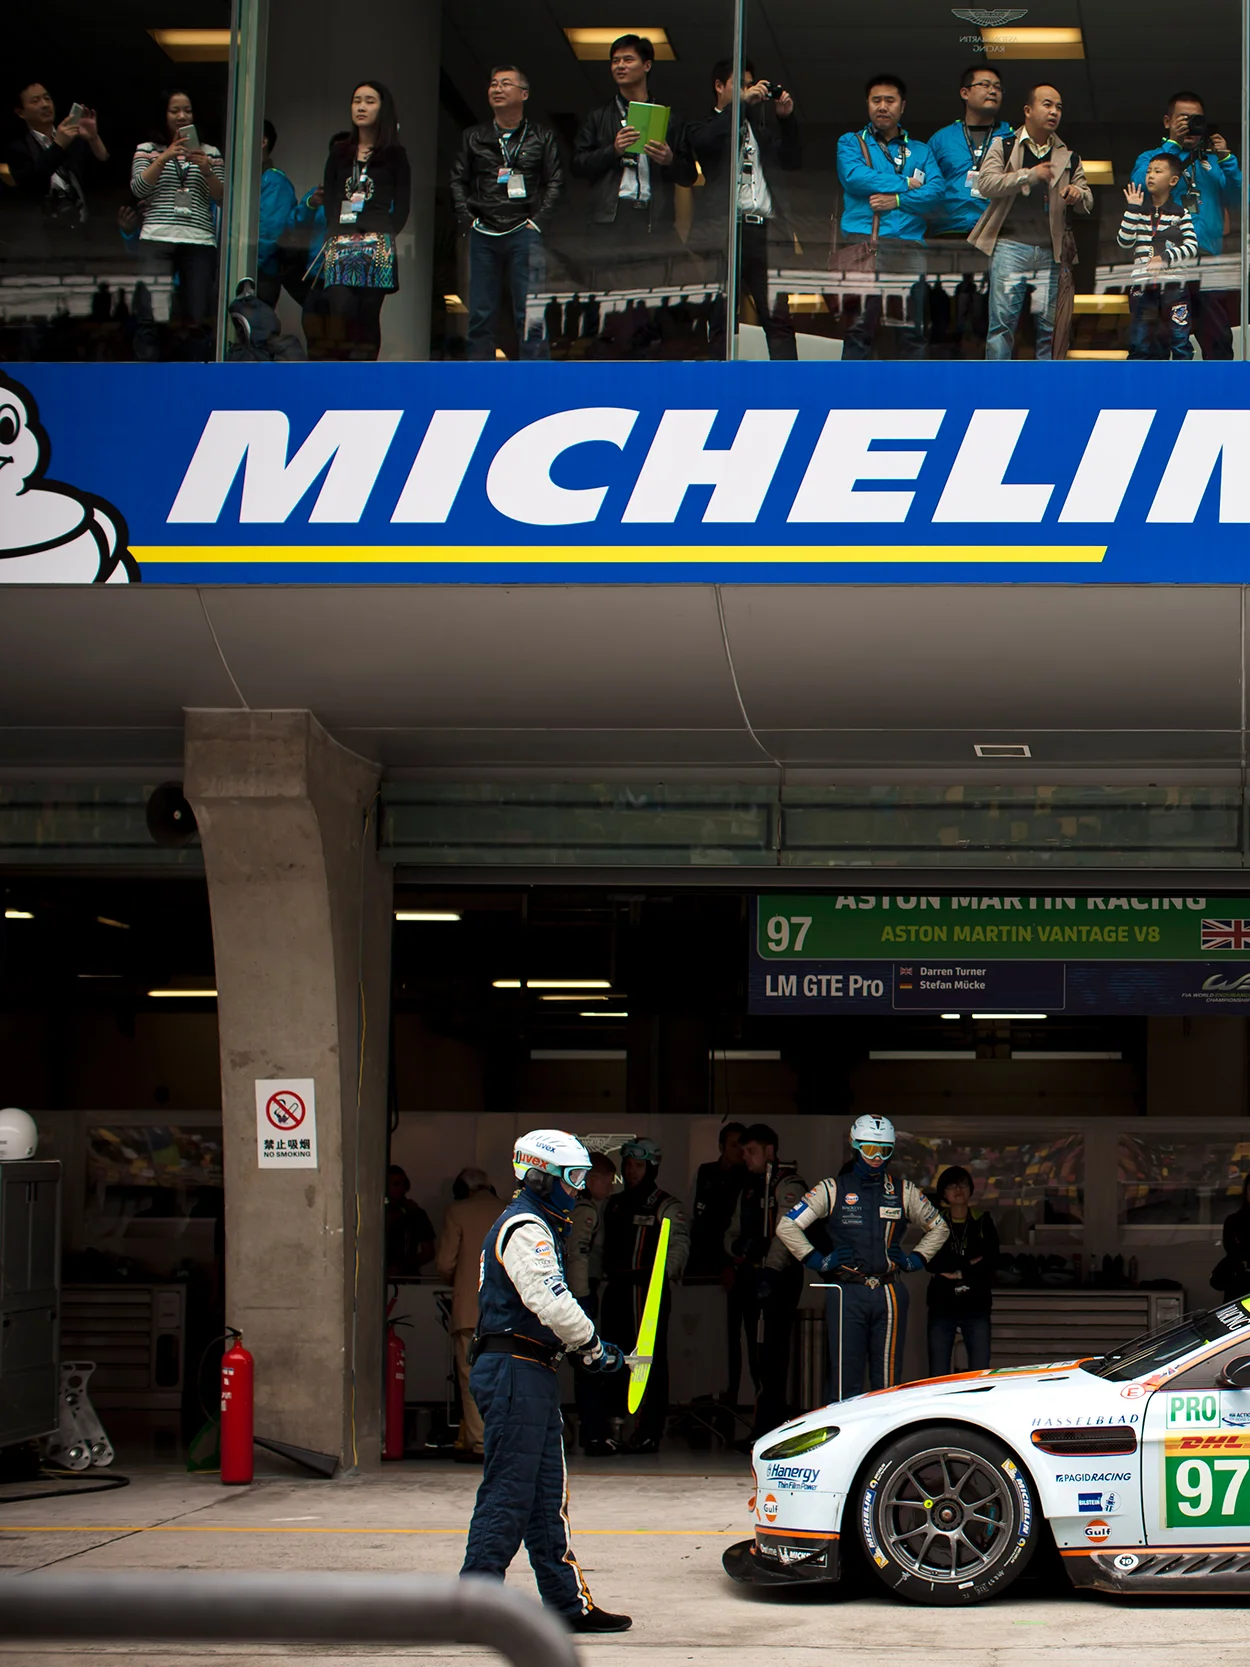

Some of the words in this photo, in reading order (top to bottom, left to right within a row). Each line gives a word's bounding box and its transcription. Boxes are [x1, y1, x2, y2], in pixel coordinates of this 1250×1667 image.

[767, 916, 813, 952] 97
[881, 926, 947, 942] ASTON
[953, 926, 1032, 942] MARTIN
[1037, 926, 1129, 942] VANTAGE
[1133, 926, 1161, 942] V8
[920, 967, 953, 976] Darren
[955, 967, 986, 976] Turner
[766, 975, 797, 997] LM
[803, 975, 843, 997] GTE
[849, 975, 884, 997] Pro
[920, 980, 952, 990] Stefan
[954, 980, 986, 990] Mücke
[264, 1139, 311, 1150] 禁止吸烟
[536, 1141, 556, 1154] uvex
[1170, 1395, 1217, 1422] PRO
[1032, 1413, 1139, 1427] HASSELBLAD
[1180, 1436, 1244, 1450] DHL
[771, 1464, 821, 1483] Hanergy
[1176, 1459, 1250, 1517] 97
[763, 1504, 779, 1513] Gulf
[1016, 1478, 1031, 1535] MICHELIN
[862, 1492, 875, 1549] MICHELIN
[1084, 1528, 1111, 1536] Gulf
